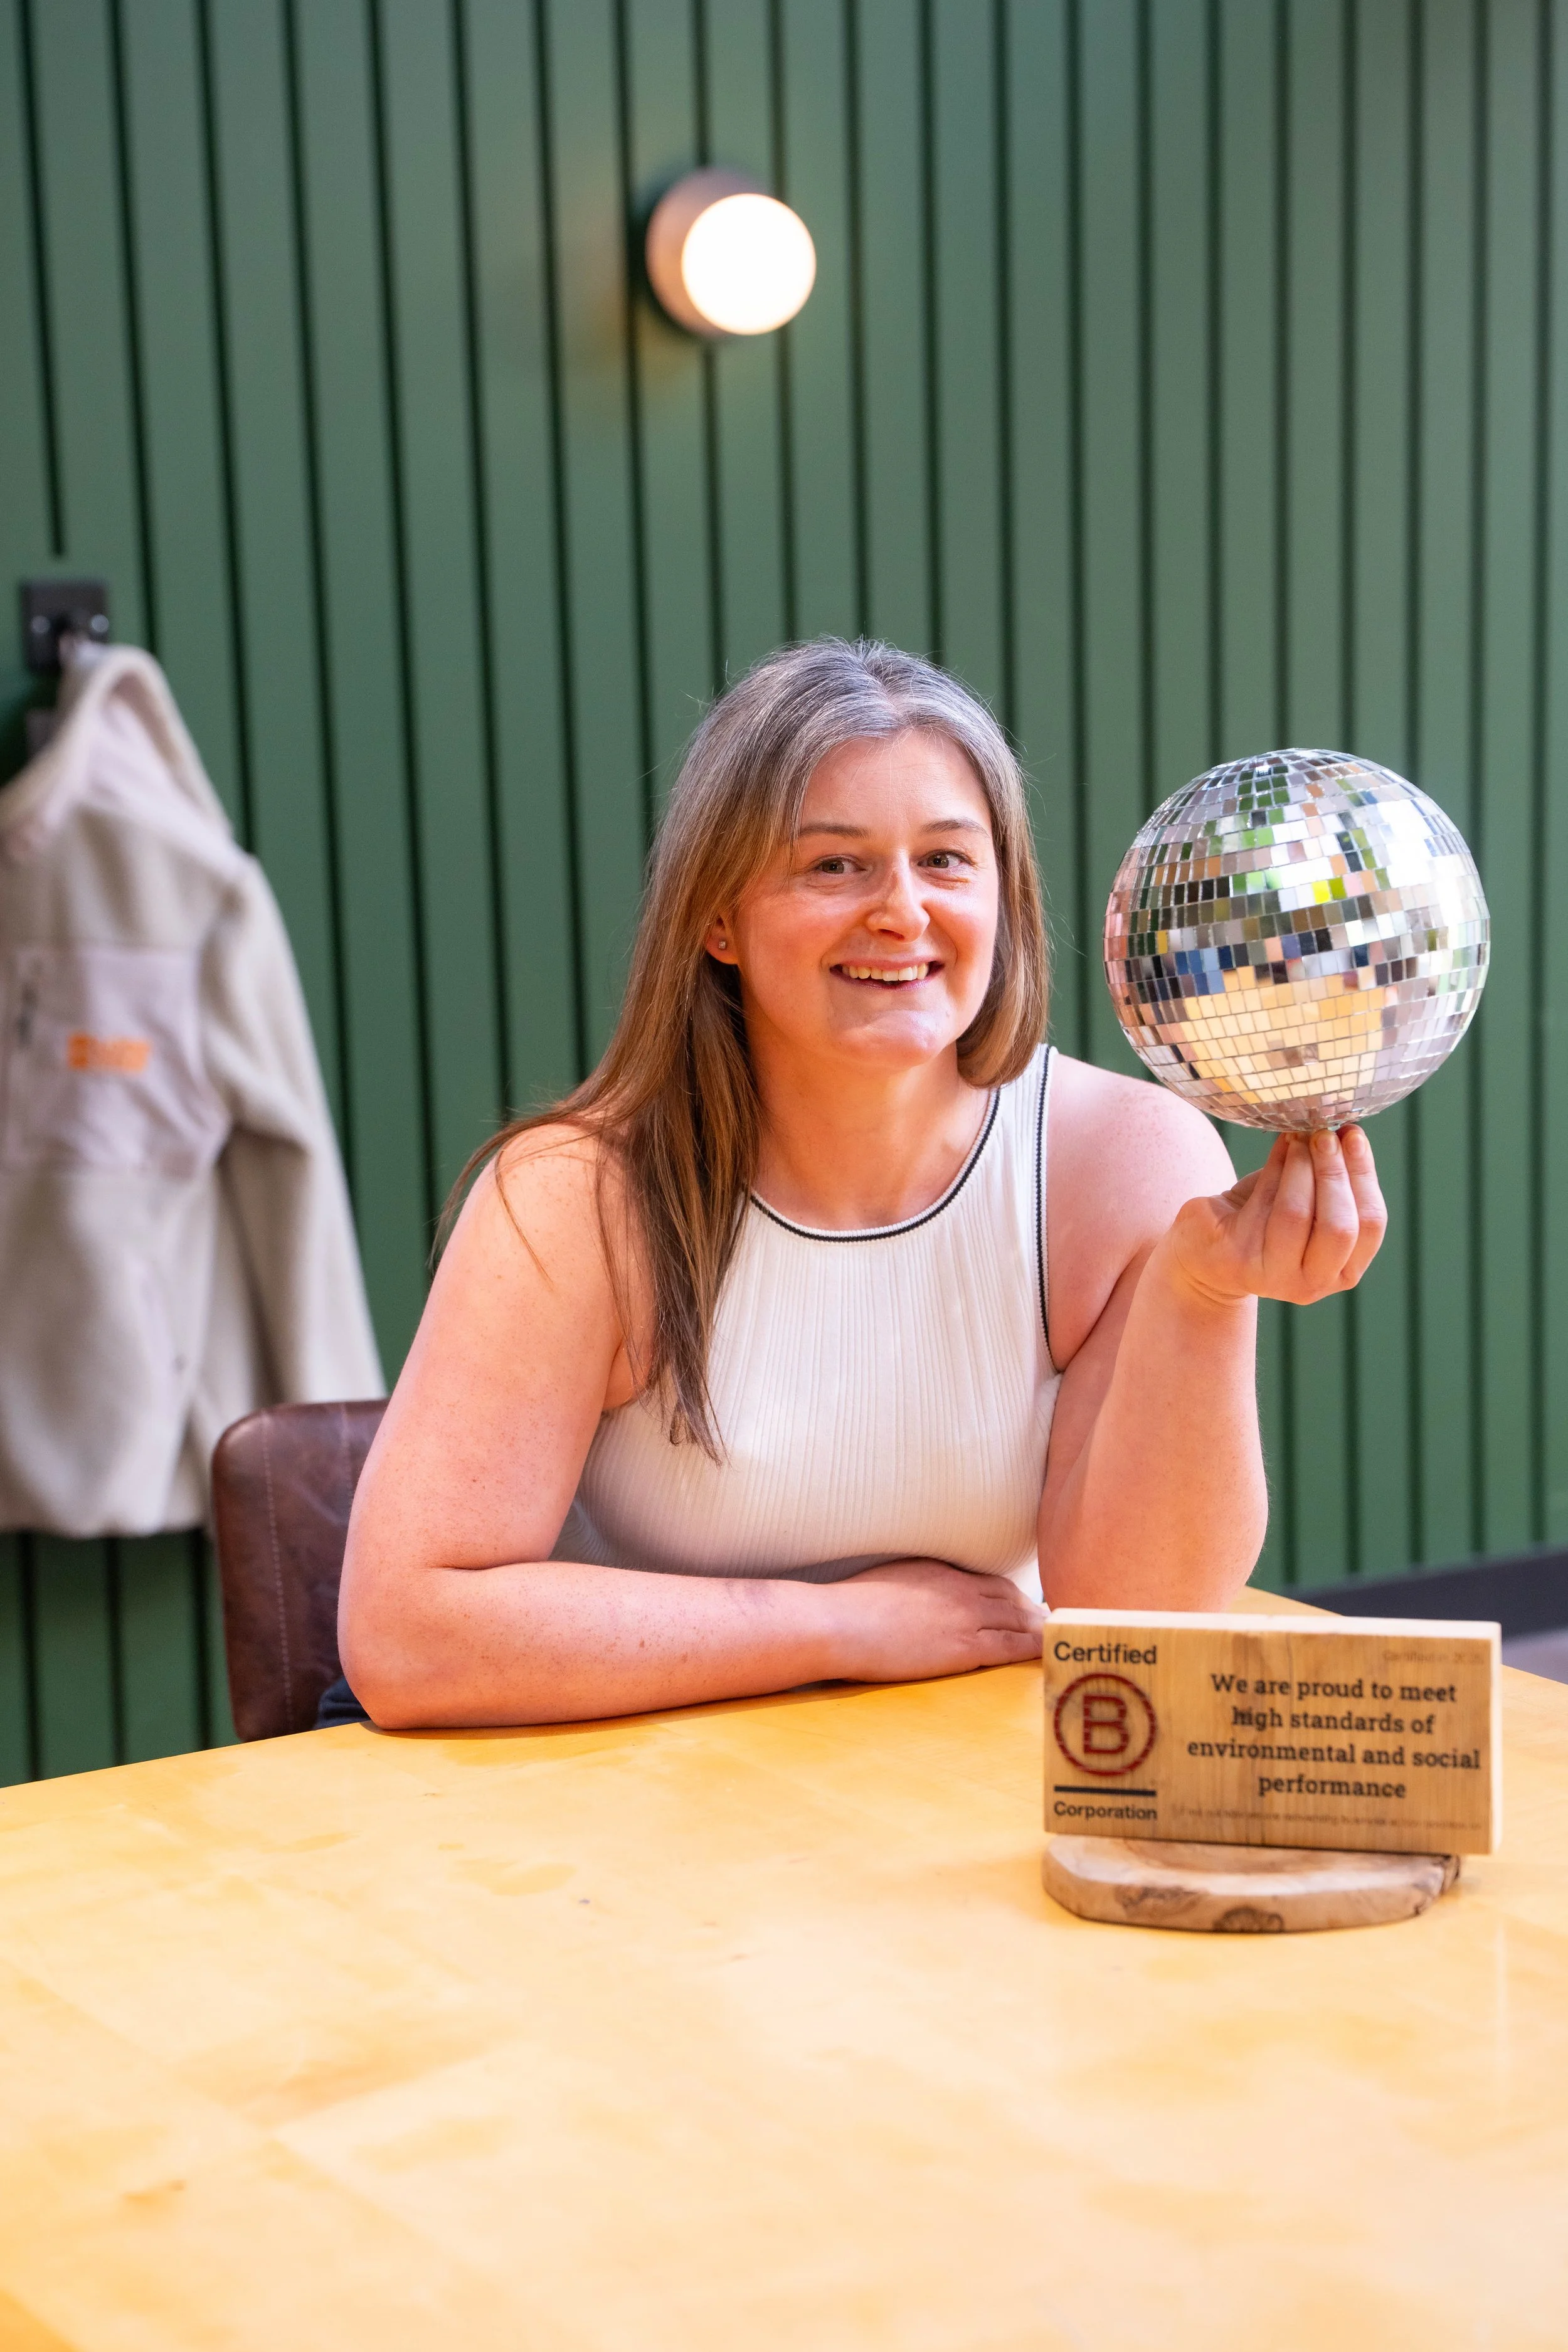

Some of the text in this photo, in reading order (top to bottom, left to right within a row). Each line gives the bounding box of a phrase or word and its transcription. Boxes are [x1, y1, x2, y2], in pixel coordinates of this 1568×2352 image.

[1054, 1641, 1157, 1665] Certified
[1210, 1673, 1456, 1702] We are proud to meet
[1083, 1694, 1130, 1754] B
[1232, 1706, 1435, 1735] high standards of
[1188, 1739, 1480, 1770] environmental and social
[1259, 1776, 1406, 1799] performance
[1054, 1801, 1157, 1821] Corporation
